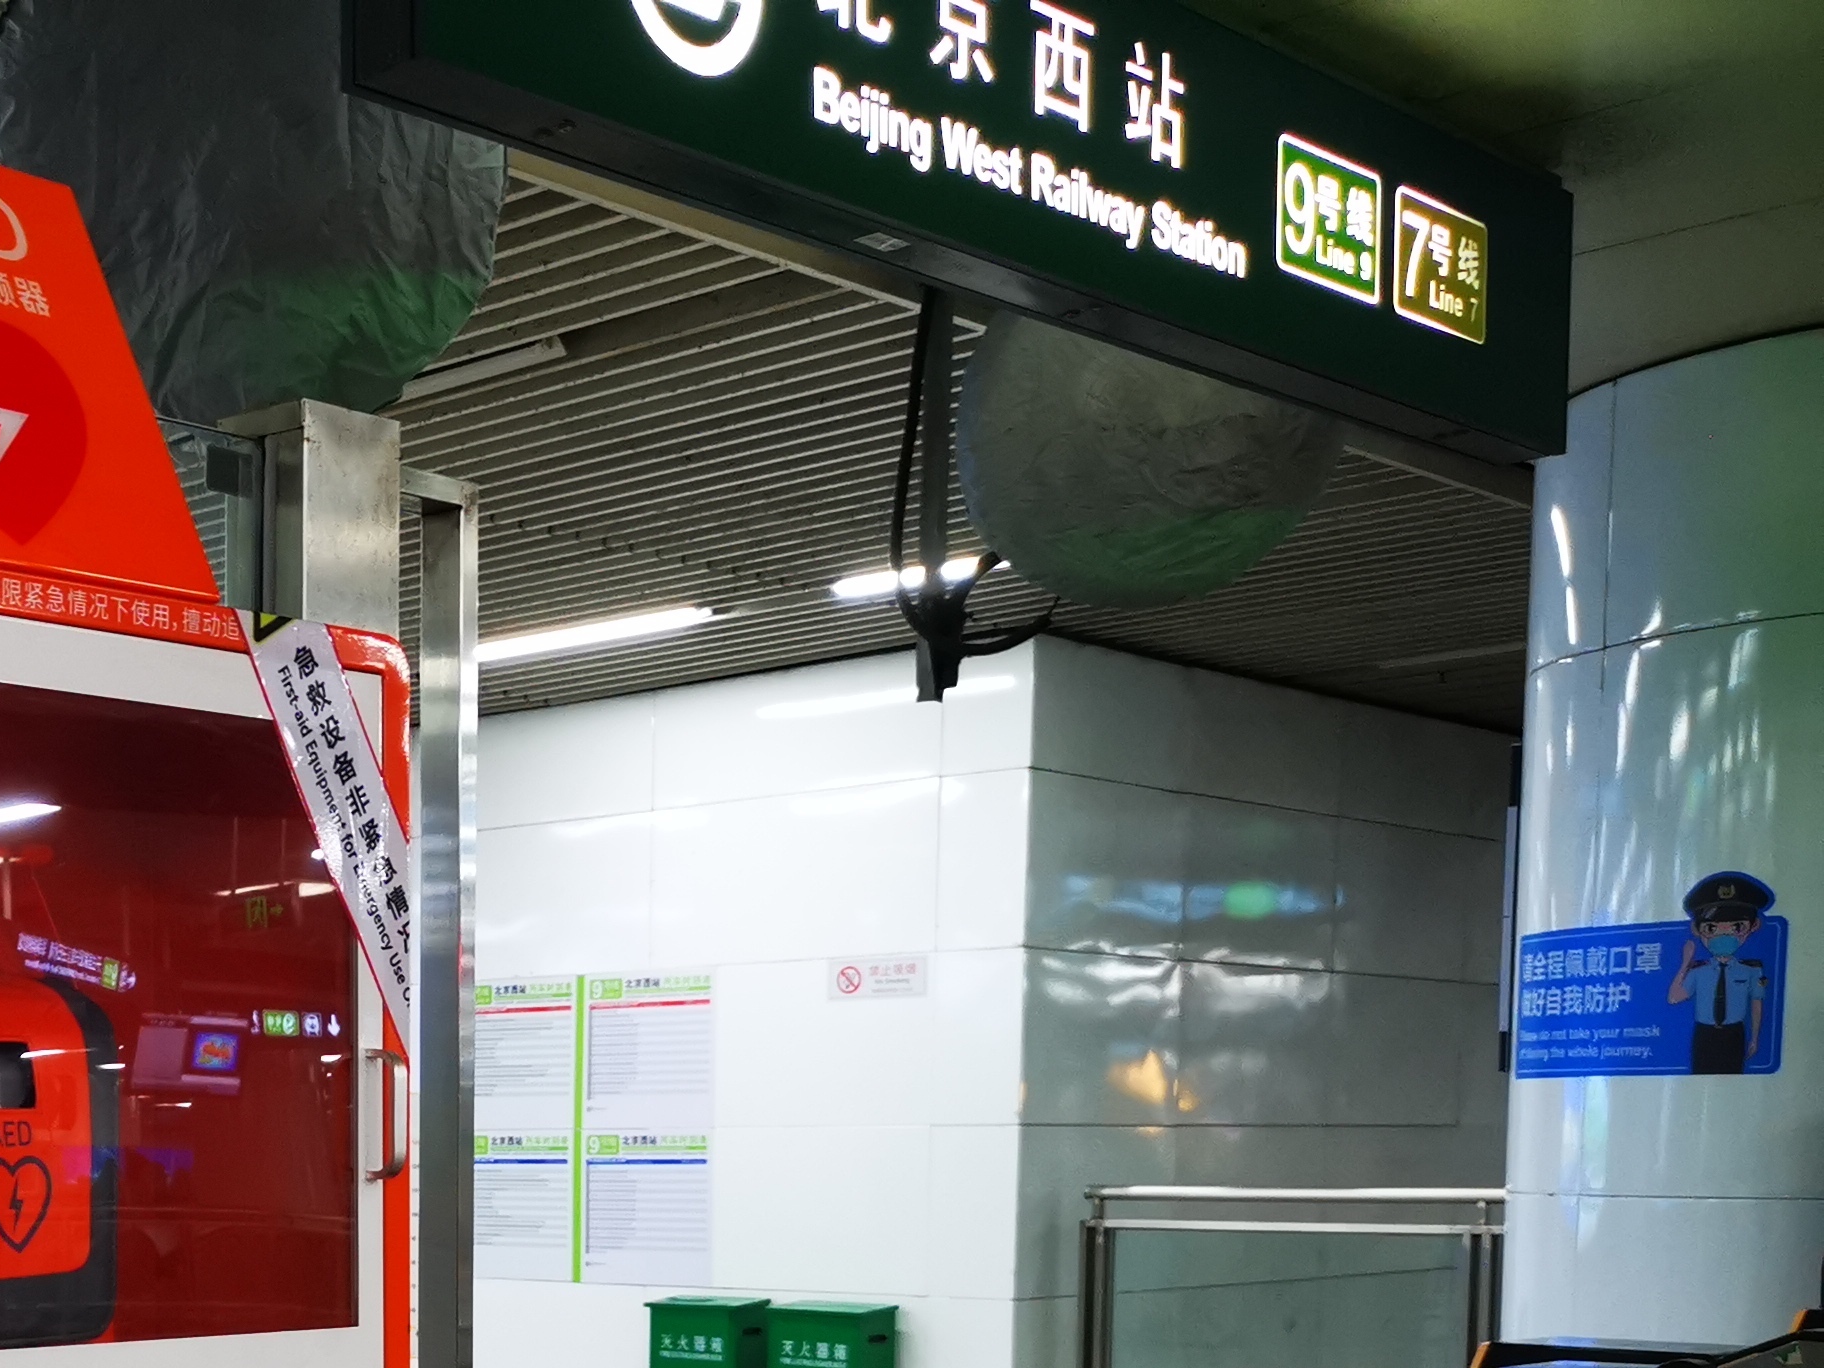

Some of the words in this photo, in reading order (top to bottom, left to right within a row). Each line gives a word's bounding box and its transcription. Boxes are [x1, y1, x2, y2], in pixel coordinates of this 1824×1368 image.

[812, 64, 933, 173] Beijing
[942, 116, 1023, 195] West
[1029, 152, 1145, 252] Railway
[1150, 199, 1248, 279] Station
[1315, 234, 1356, 275] Line
[1359, 251, 1373, 281] 9
[1429, 279, 1464, 318] Line
[1470, 297, 1479, 323] 7
[278, 664, 311, 739] First-aid
[305, 739, 347, 833] Equipment
[341, 834, 358, 859] for
[389, 952, 406, 985] Use
[1592, 1028, 1620, 1042] your
